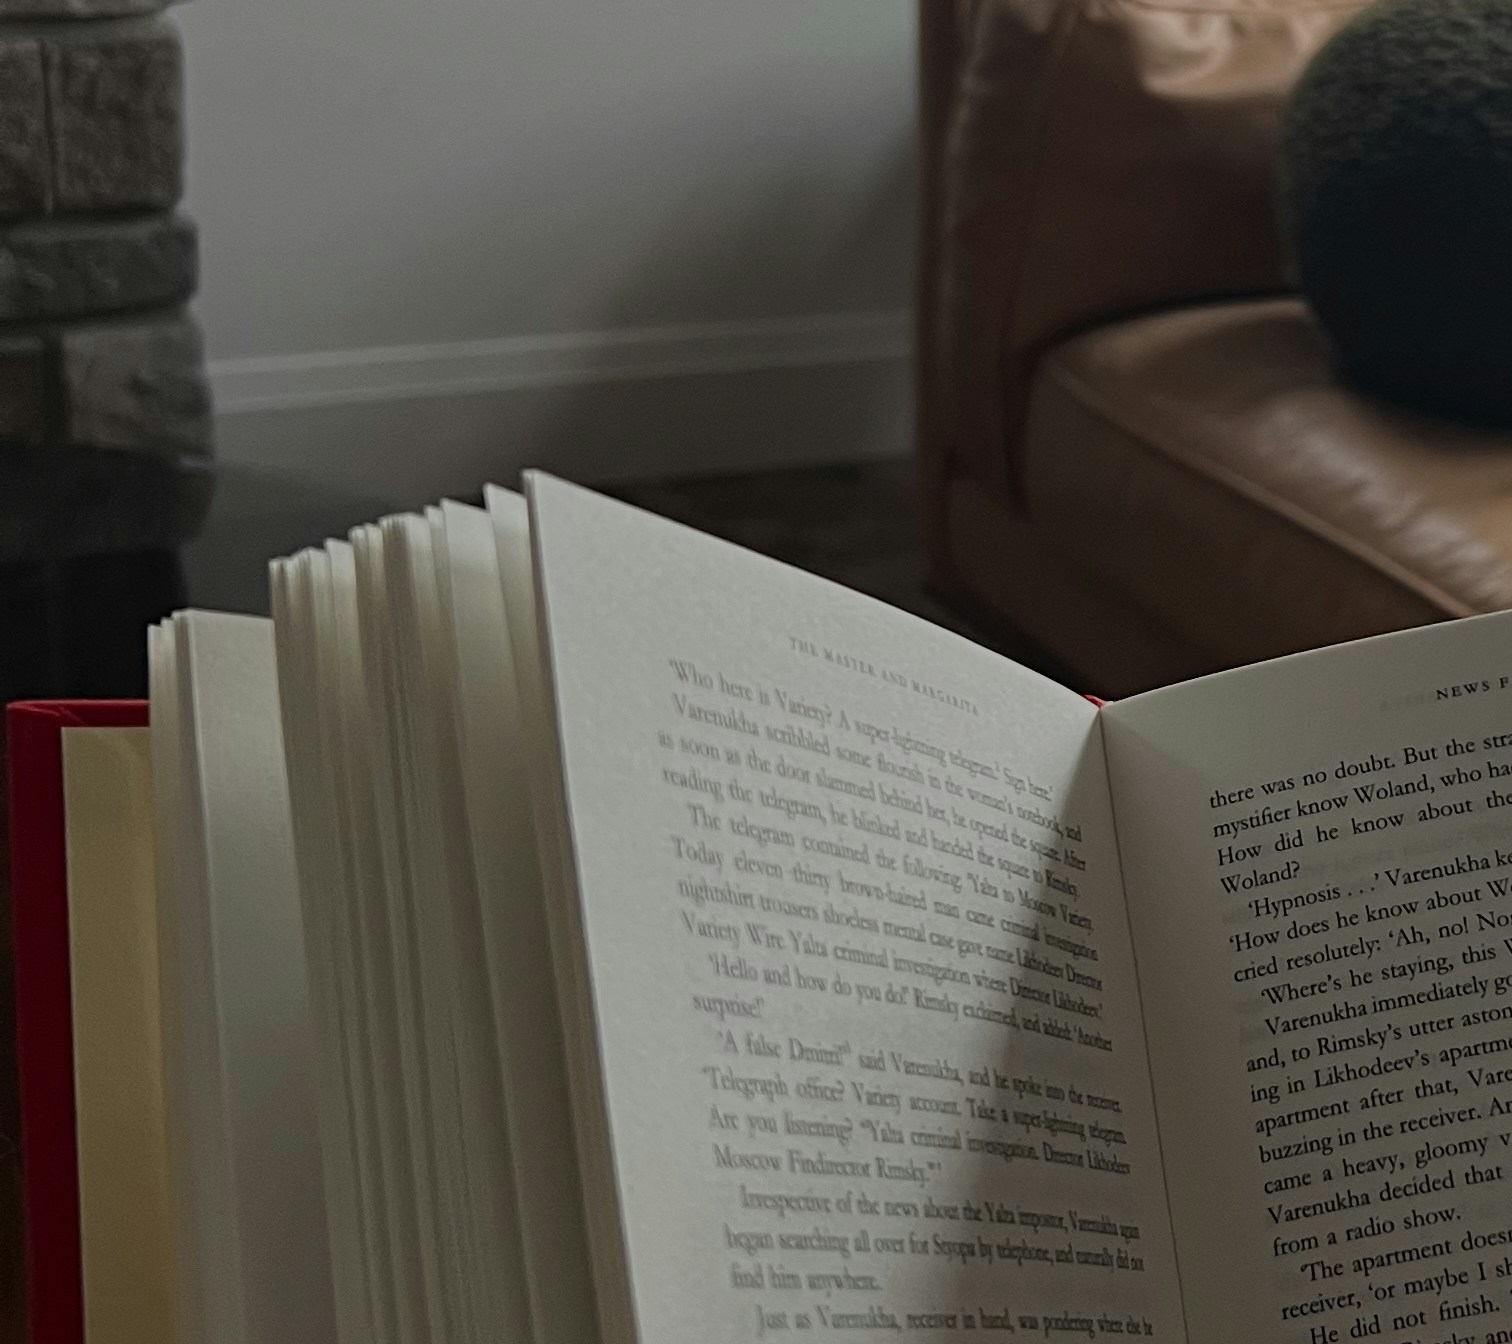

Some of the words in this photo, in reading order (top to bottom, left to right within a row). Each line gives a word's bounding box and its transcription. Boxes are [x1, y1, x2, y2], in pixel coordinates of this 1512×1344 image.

[1435, 679, 1490, 700] NEWS
[1208, 786, 1255, 809] there
[1259, 776, 1295, 795] was
[1301, 770, 1327, 787] no
[1333, 753, 1396, 779] doubt.
[1401, 746, 1439, 766] But
[1444, 737, 1476, 757] the
[1212, 805, 1291, 840] mystifier
[1295, 794, 1349, 817] know
[1351, 772, 1435, 804] Woland,
[1438, 766, 1482, 787] who
[1216, 843, 1262, 867] How
[1273, 828, 1304, 852] did
[1314, 824, 1339, 843] he
[1350, 812, 1405, 835] know
[1416, 799, 1473, 822] about
[1219, 859, 1300, 894] Woland?
[1263, 1000, 1368, 1036] Varenukha
[1370, 974, 1489, 1014] immediately
[1257, 1134, 1334, 1164] buzzing
[1336, 1126, 1357, 1147] in
[1361, 1120, 1394, 1142] the
[1398, 1106, 1482, 1134] receiver.
